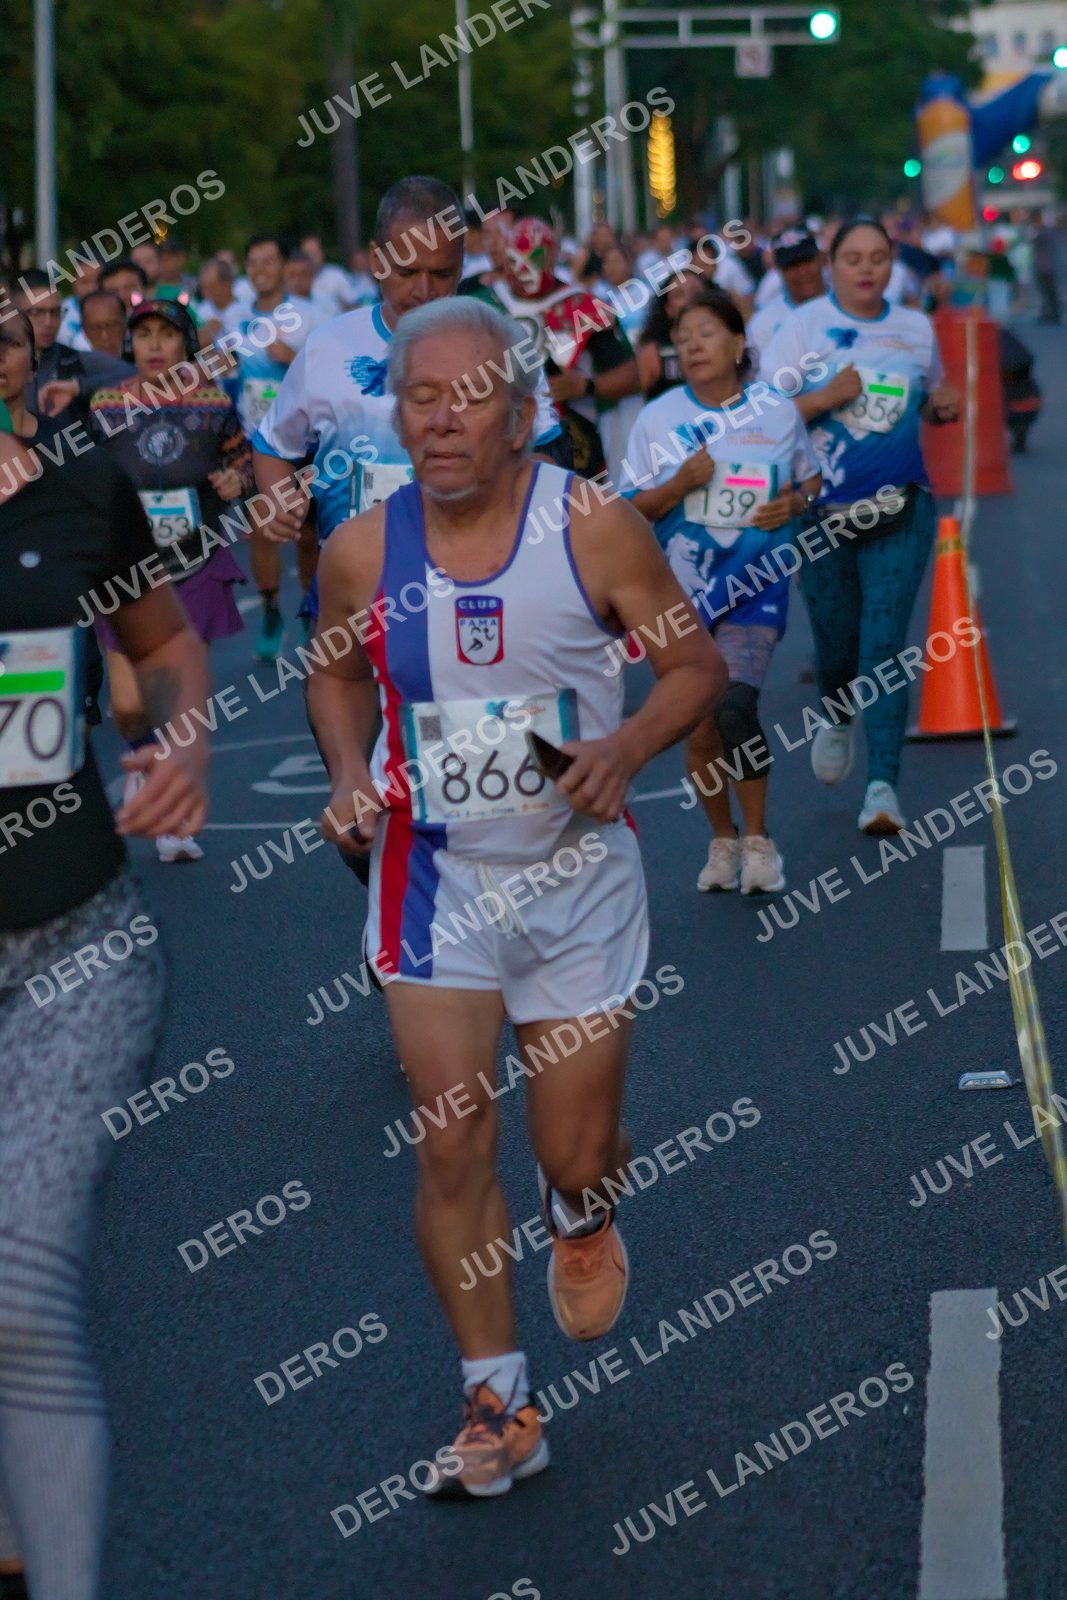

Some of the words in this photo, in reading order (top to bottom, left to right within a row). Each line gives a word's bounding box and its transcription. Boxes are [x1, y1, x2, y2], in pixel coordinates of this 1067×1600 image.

[701, 487, 757, 518] 139
[457, 599, 498, 611] CLUB
[459, 618, 498, 627] FAMA
[441, 749, 546, 804] 866
